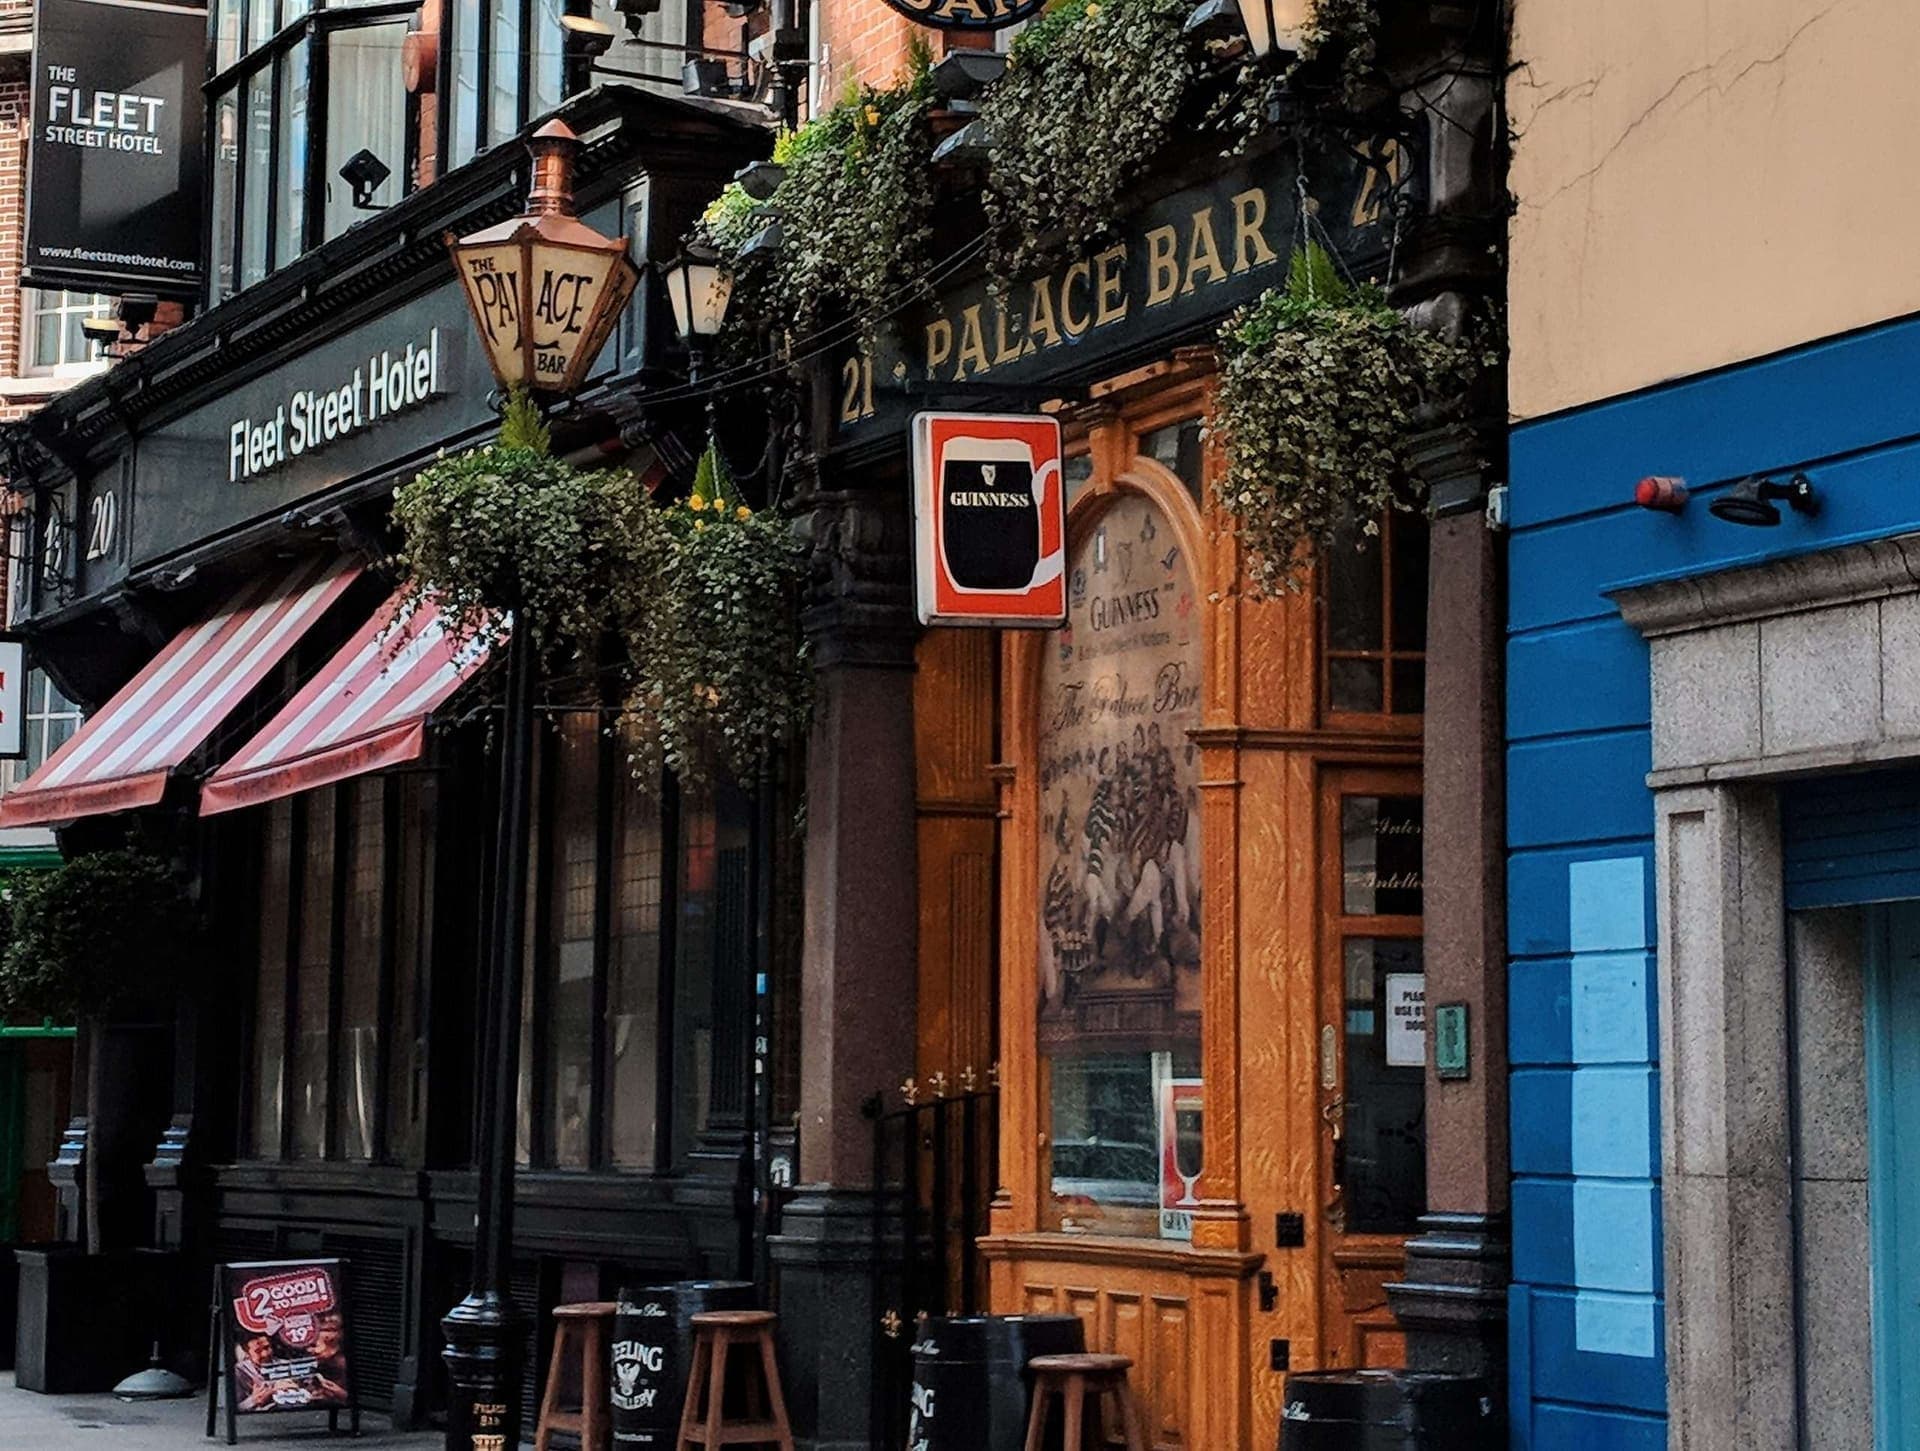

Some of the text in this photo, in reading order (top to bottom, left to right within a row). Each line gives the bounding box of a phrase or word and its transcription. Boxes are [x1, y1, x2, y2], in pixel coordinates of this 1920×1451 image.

[48, 65, 76, 82] THE
[48, 86, 165, 133] FLEET
[46, 125, 163, 155] STREET HOTEL
[39, 246, 195, 271] www.fleetstreethotel.com
[468, 256, 496, 273] THE
[472, 270, 593, 350] PALACE
[842, 187, 1278, 423] 21 PALACE BAR
[537, 353, 566, 374] BAR
[230, 326, 438, 483] Fleet Street Hotel
[950, 491, 1029, 508] GUINNESS
[86, 490, 116, 561] 20
[1090, 587, 1160, 632] GUINNESS
[1153, 661, 1199, 714] Bar
[250, 1287, 273, 1316] 2
